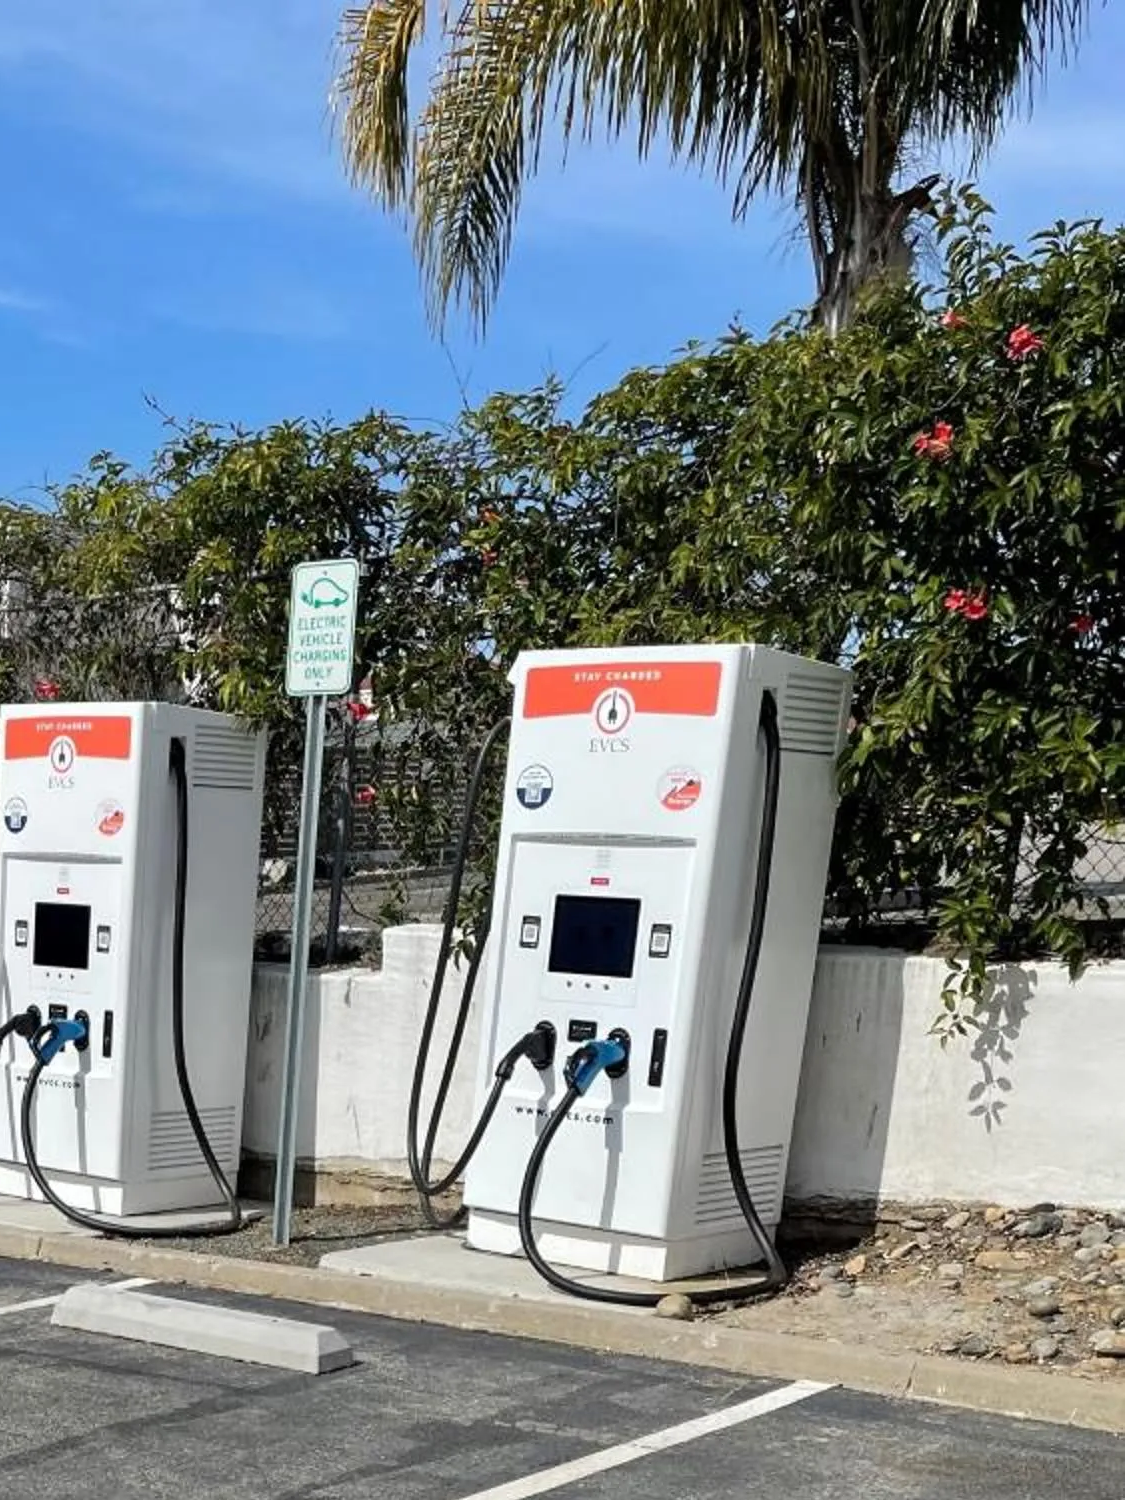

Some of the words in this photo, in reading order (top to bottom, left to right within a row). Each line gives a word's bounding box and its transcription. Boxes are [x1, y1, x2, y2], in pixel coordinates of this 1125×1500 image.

[297, 615, 346, 631] ELECTRIC
[299, 632, 343, 647] VEHICLE
[293, 649, 347, 664] CHARGING
[304, 667, 334, 680] ONLY
[573, 672, 602, 682] STAY
[605, 670, 663, 682] CHARGED
[589, 737, 631, 753] EVCS
